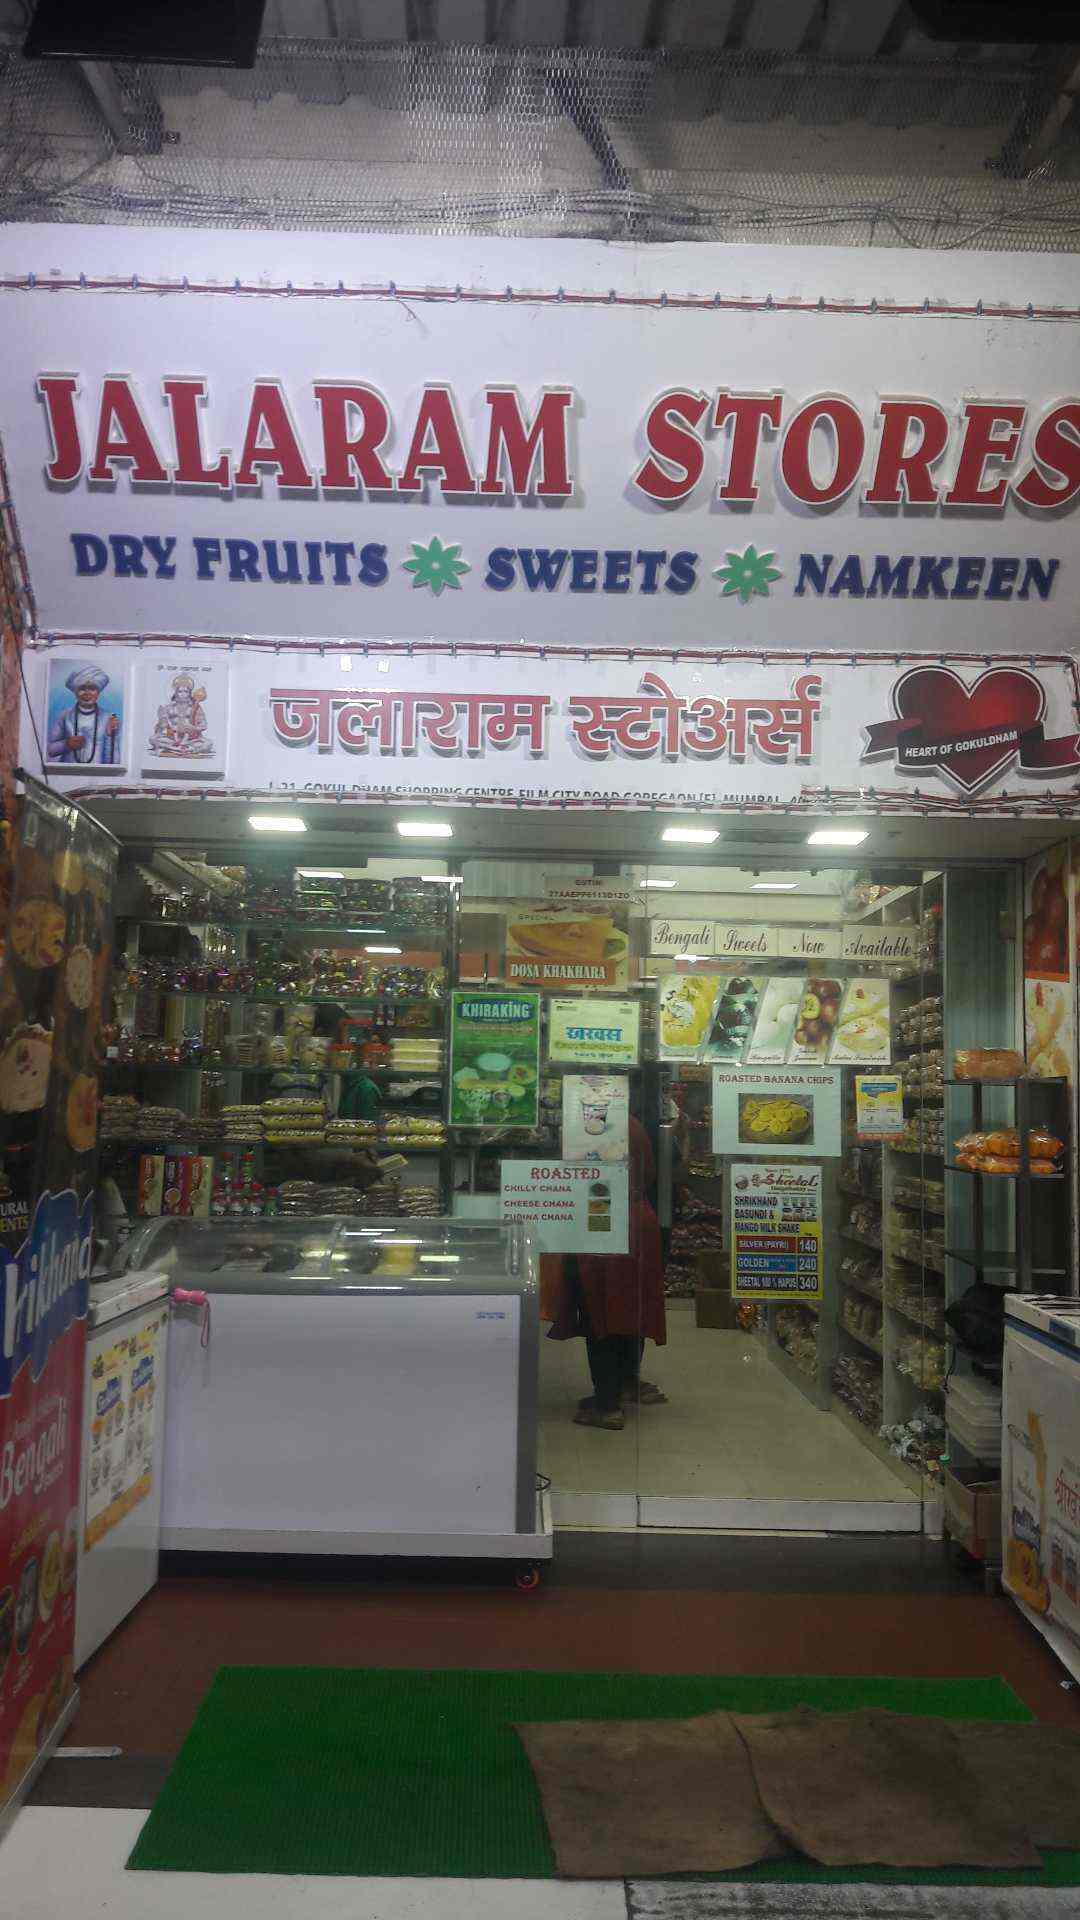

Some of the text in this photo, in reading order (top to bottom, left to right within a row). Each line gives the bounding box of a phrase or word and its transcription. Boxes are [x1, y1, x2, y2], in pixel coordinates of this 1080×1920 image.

[37, 375, 1080, 508] JALARAM STORES
[70, 533, 1060, 600] DRY FRUITS SWEETS NAMKEEN
[269, 672, 822, 757] जलाराम स्टोअर्स
[905, 730, 1018, 757] HEART OF GOKULDHAM
[654, 919, 712, 953] Bengali
[792, 932, 825, 954] Now
[511, 964, 606, 979] DOSA KHAKHARA
[719, 1074, 834, 1085] ROASTED BANANA CHIPS
[531, 1167, 600, 1180] ROASTED
[799, 1240, 817, 1252] 140
[737, 1258, 817, 1271] GOLDEN 240
[799, 1276, 817, 1290] 340
